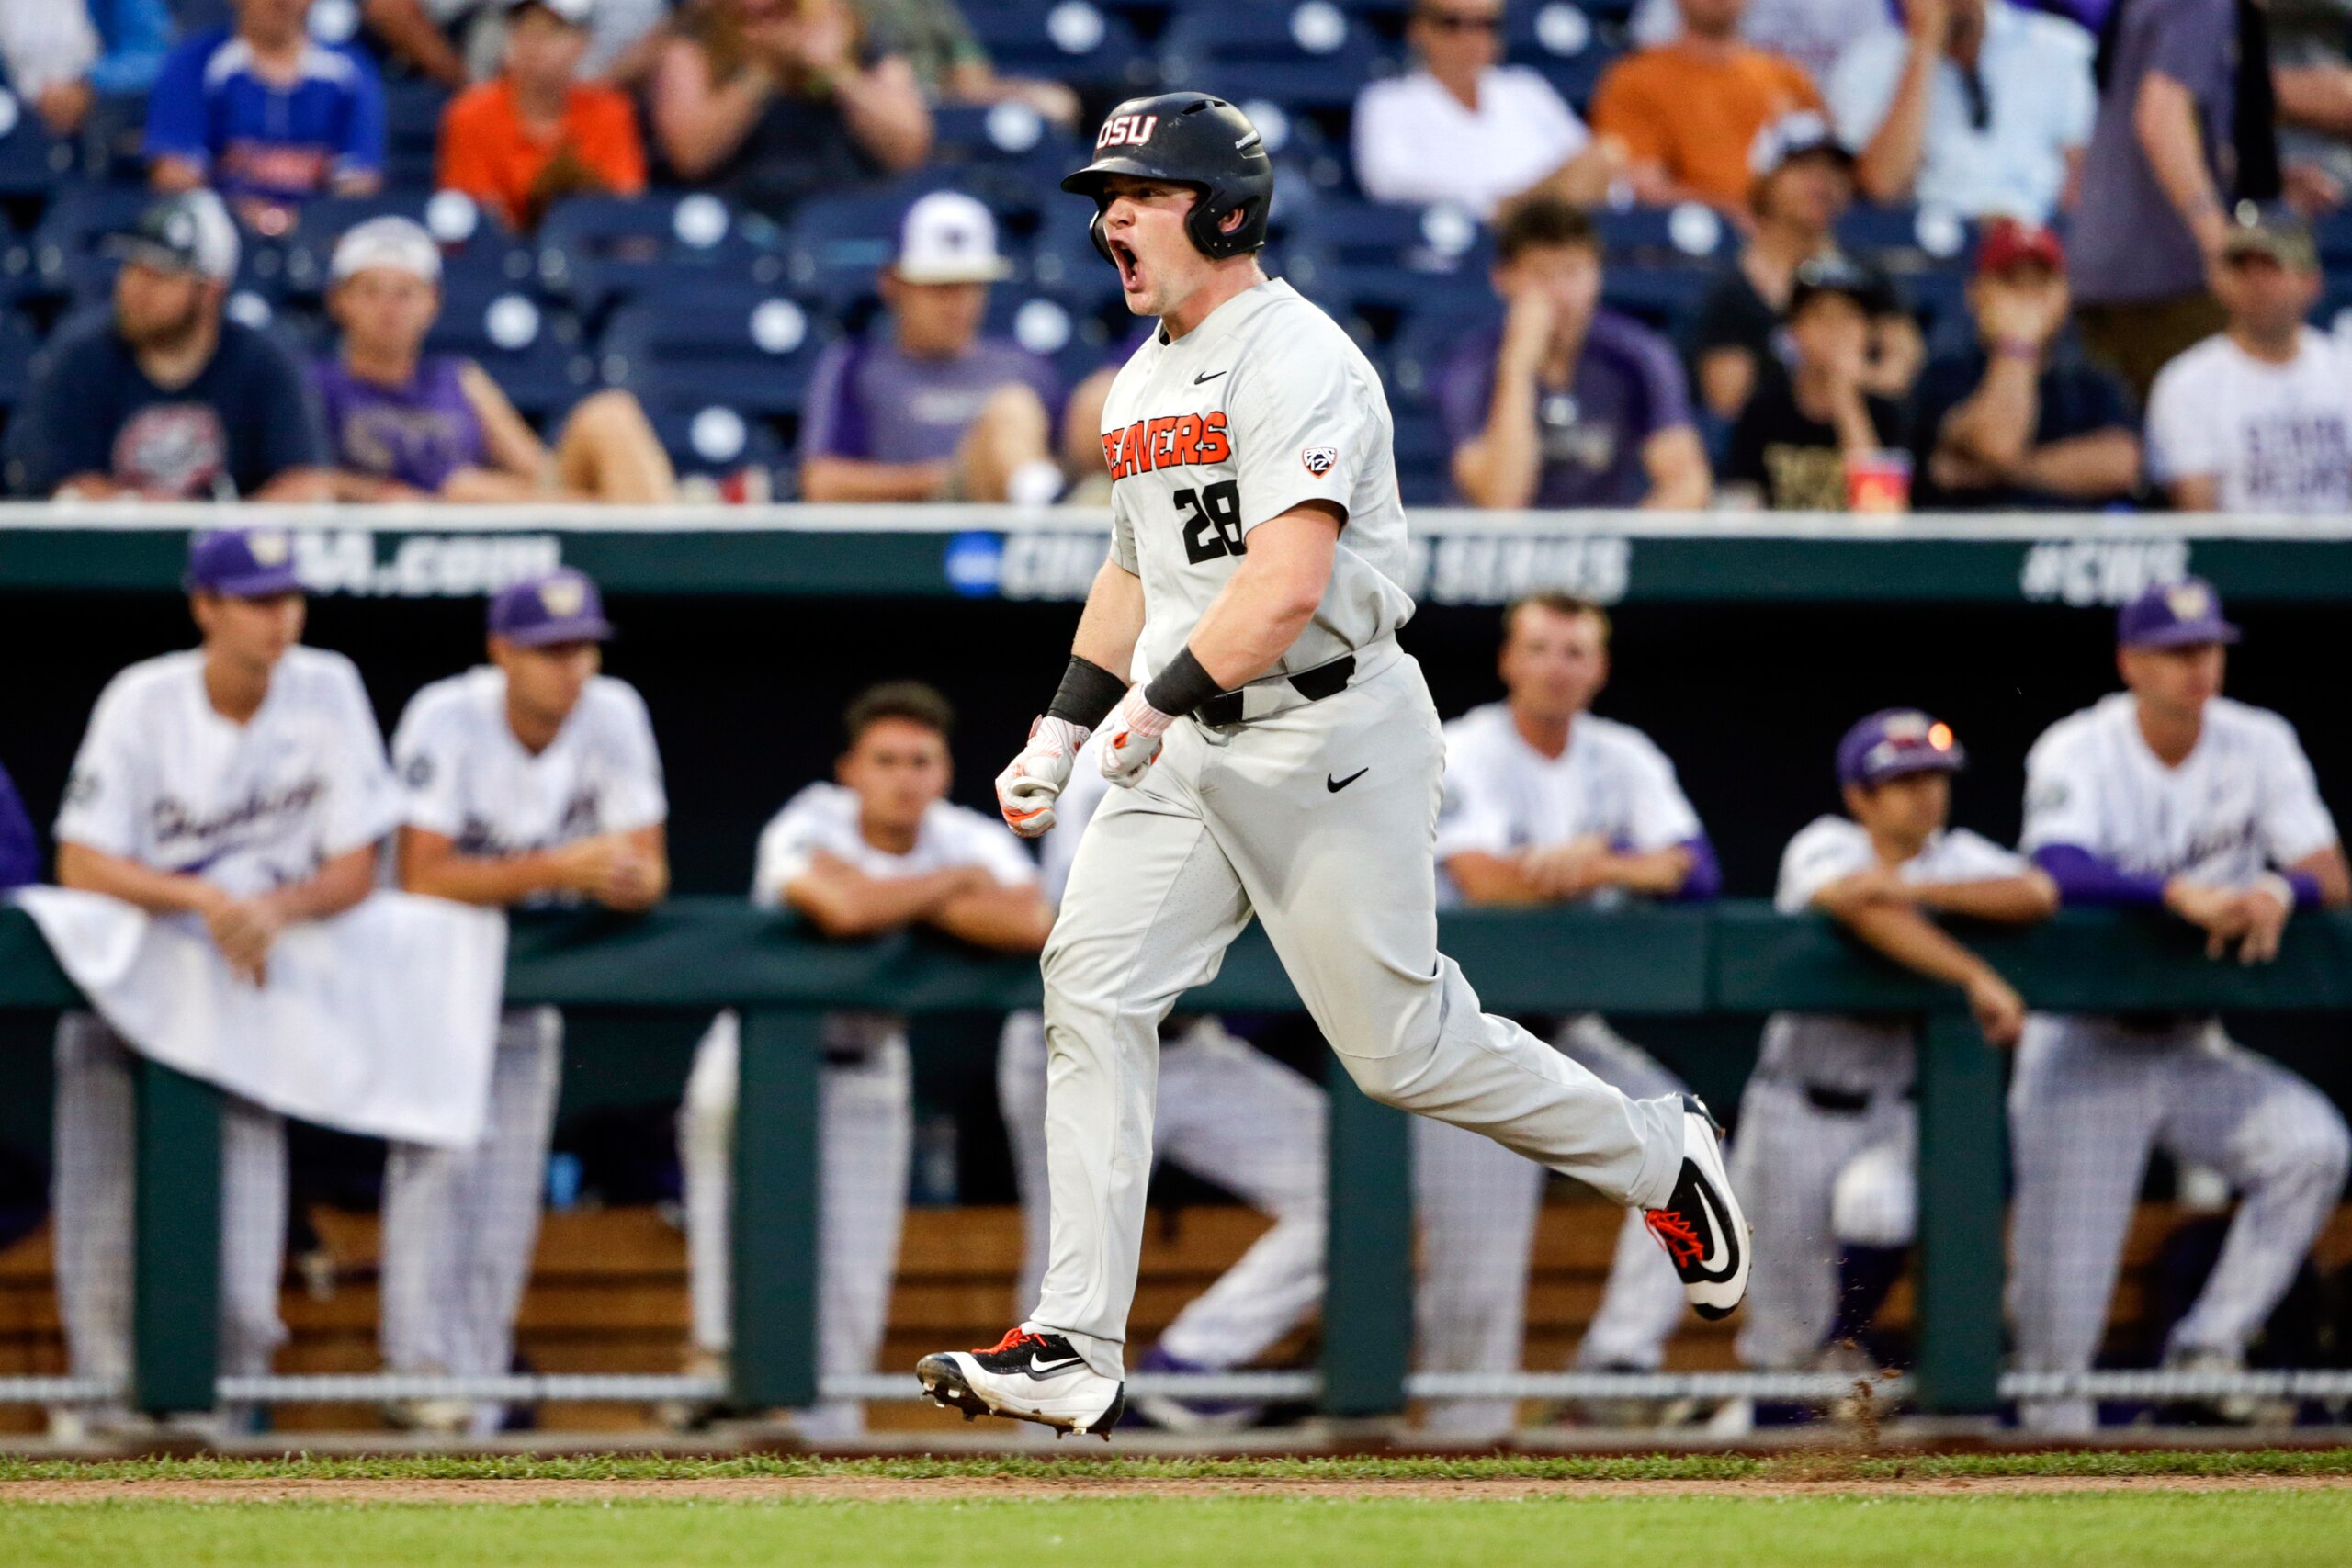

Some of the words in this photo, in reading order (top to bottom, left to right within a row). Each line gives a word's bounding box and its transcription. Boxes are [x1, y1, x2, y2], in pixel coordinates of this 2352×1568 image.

[1095, 114, 1159, 151] OSU
[1311, 458, 1328, 471] 12
[1173, 479, 1248, 565] 28
